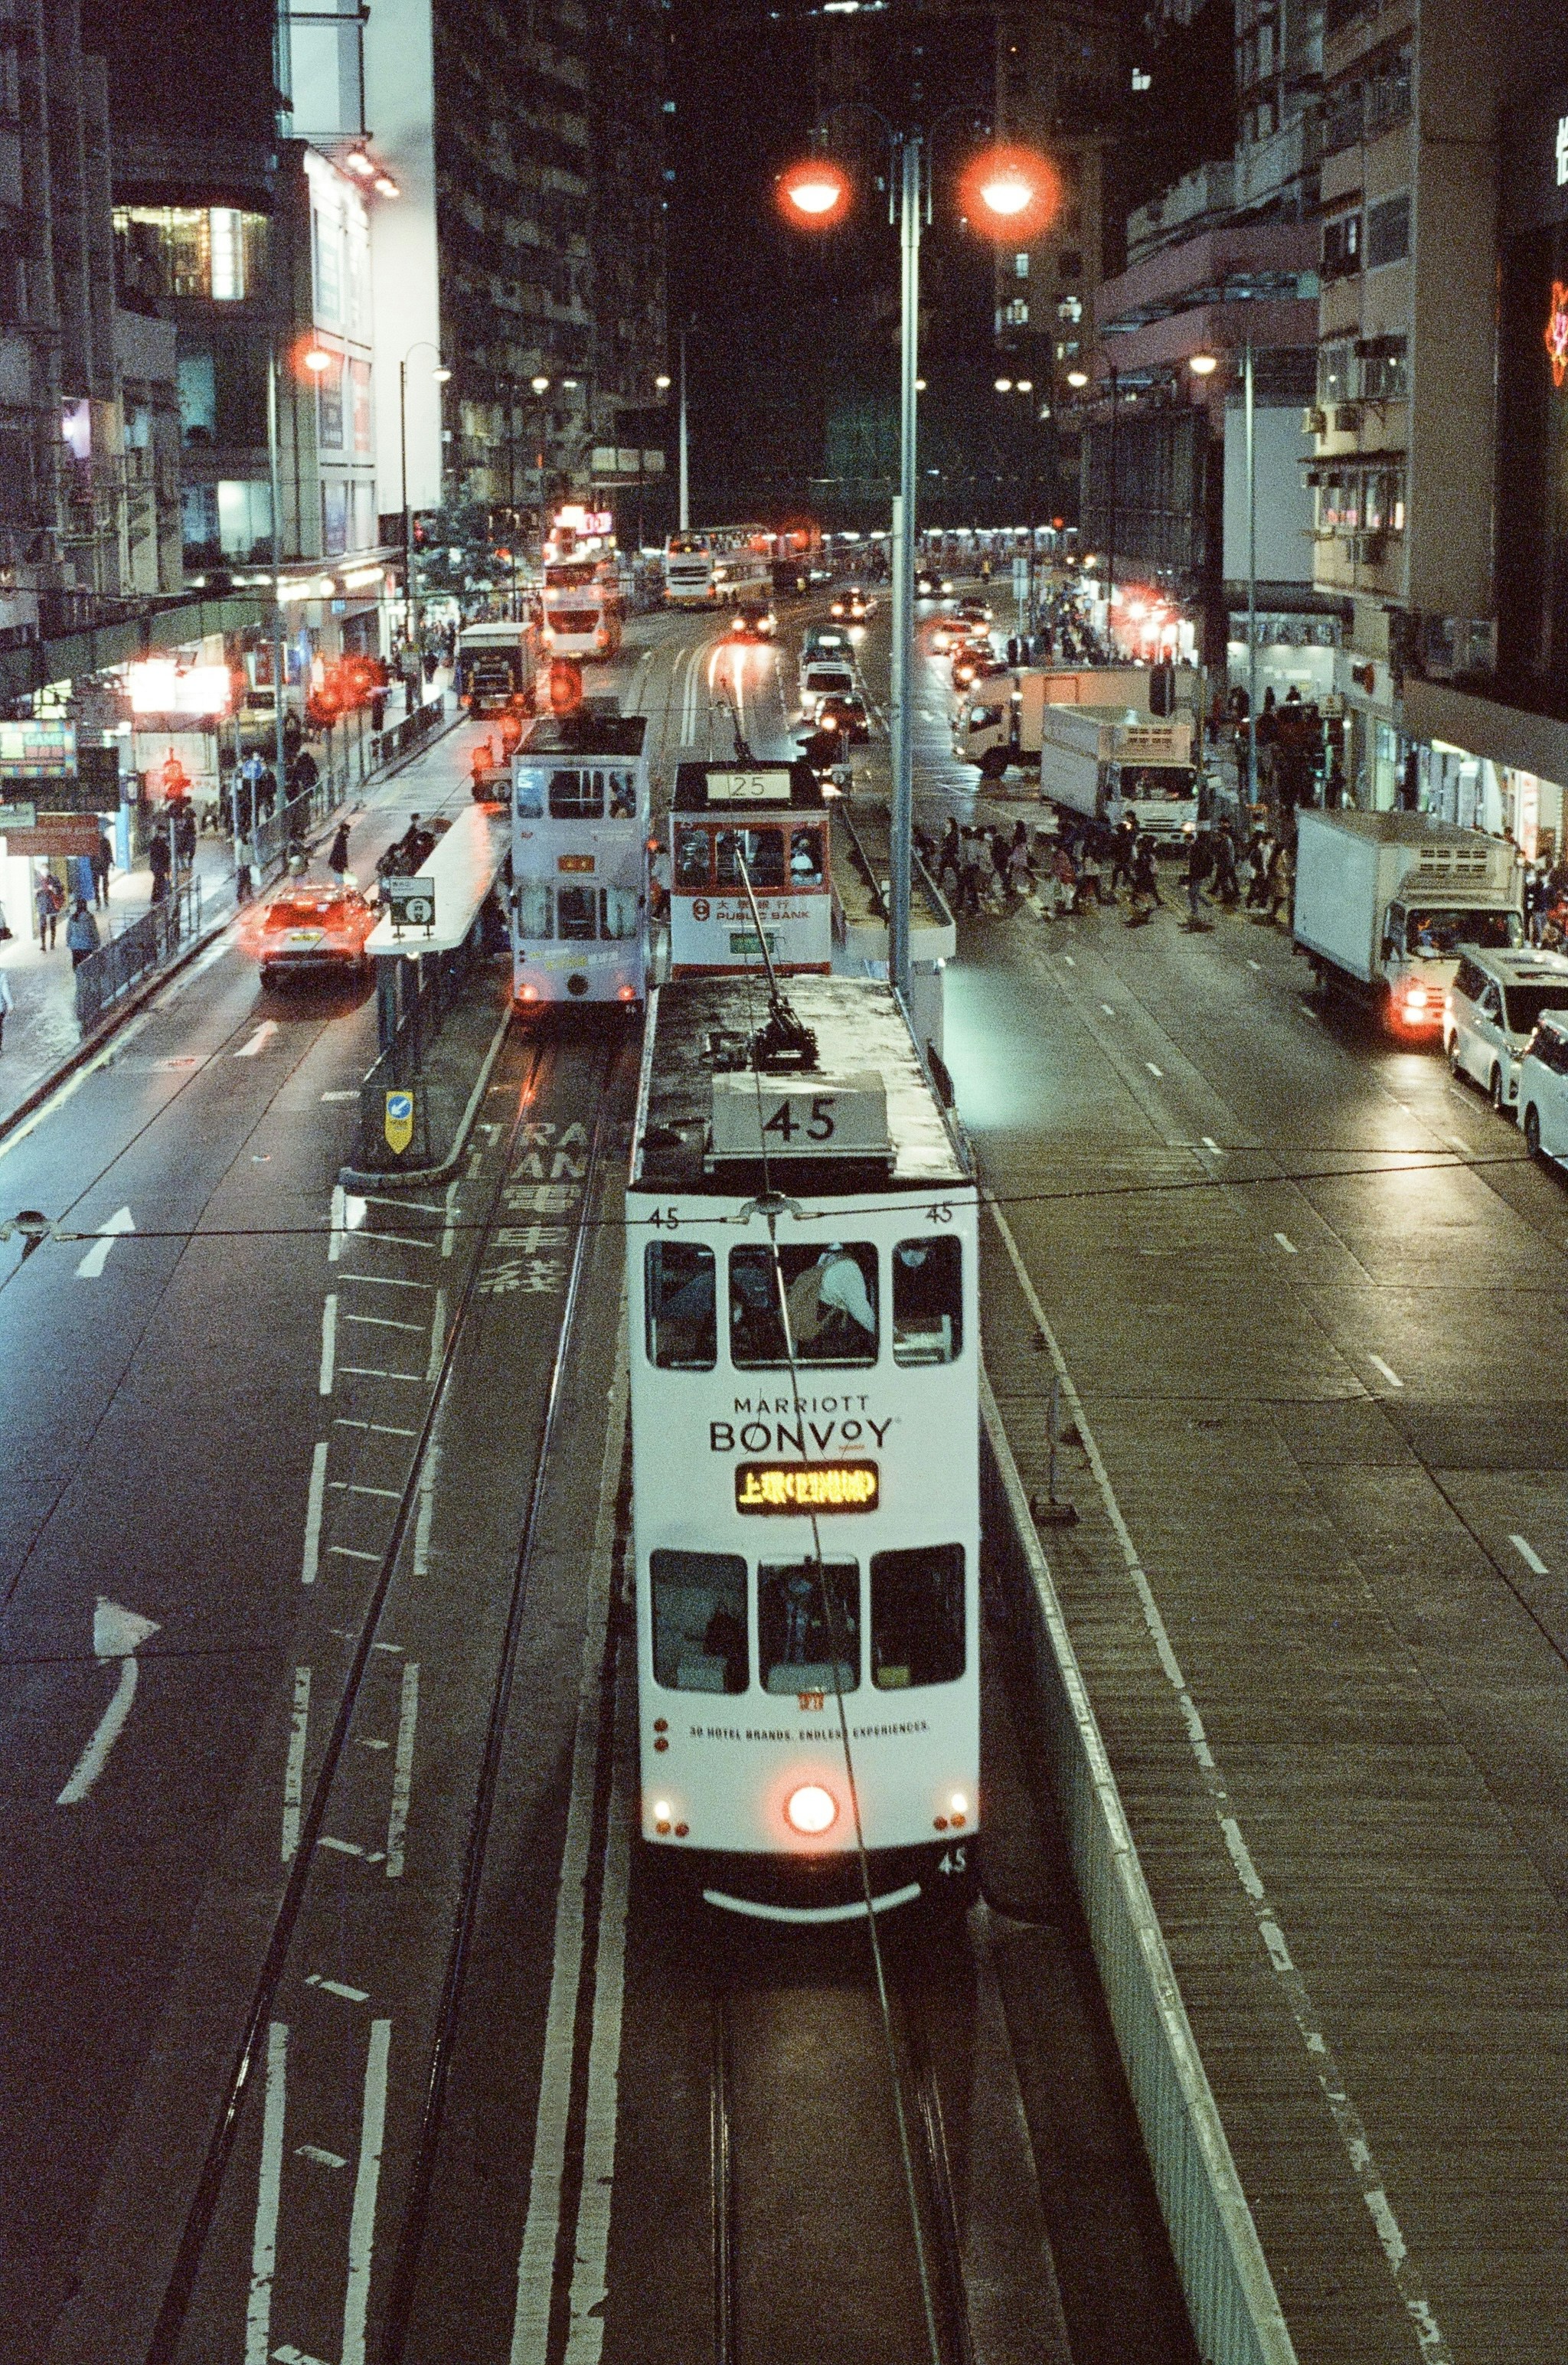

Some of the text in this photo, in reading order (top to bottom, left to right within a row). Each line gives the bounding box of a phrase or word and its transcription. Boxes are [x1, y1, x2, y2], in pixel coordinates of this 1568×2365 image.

[731, 777, 765, 796] 25
[771, 910, 810, 920] BANK
[763, 1098, 836, 1142] 45
[648, 1207, 680, 1230] 45
[926, 1200, 954, 1224] 45
[733, 1394, 869, 1414] MARRIOTT
[707, 1727, 740, 1740] HOTEL
[799, 1728, 847, 1742] ENDLES
[937, 1846, 966, 1874] 45
